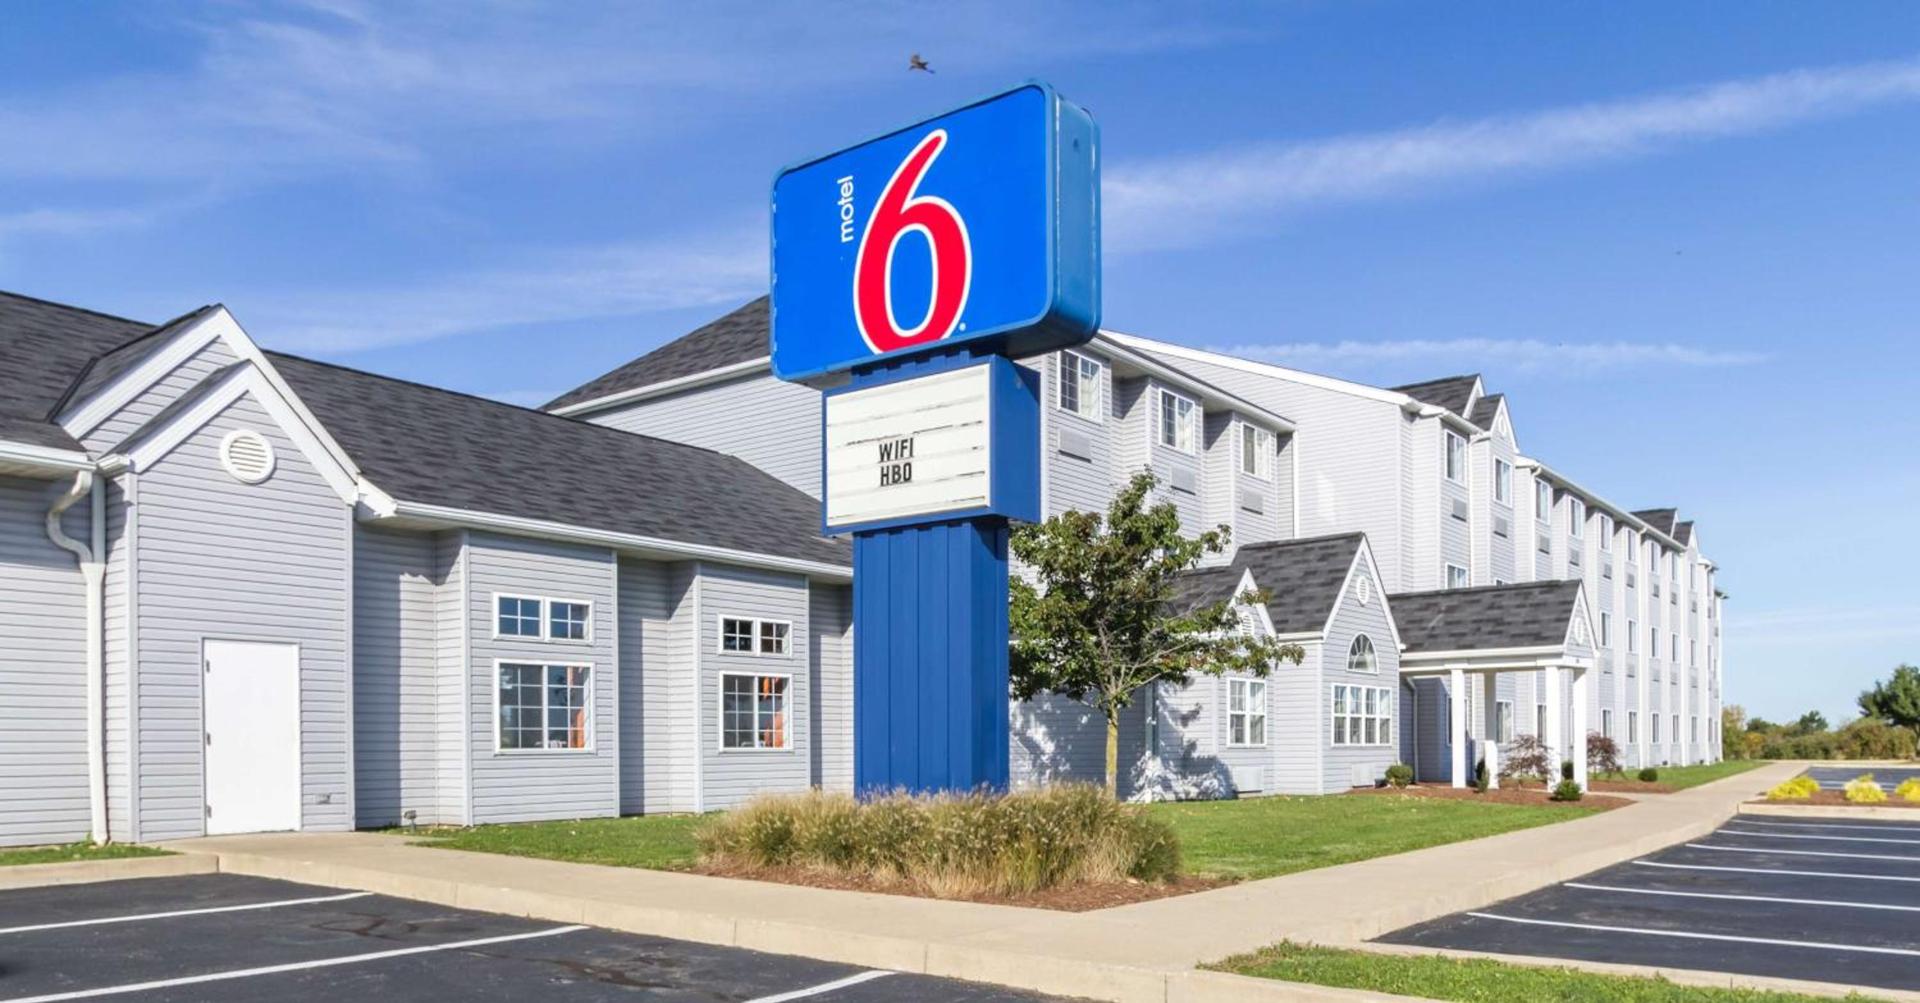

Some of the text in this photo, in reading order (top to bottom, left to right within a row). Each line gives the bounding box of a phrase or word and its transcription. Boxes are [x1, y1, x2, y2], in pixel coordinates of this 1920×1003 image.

[837, 175, 853, 243] motel
[854, 129, 972, 353] 6
[879, 437, 914, 462] WIFI
[880, 463, 913, 486] HBO
